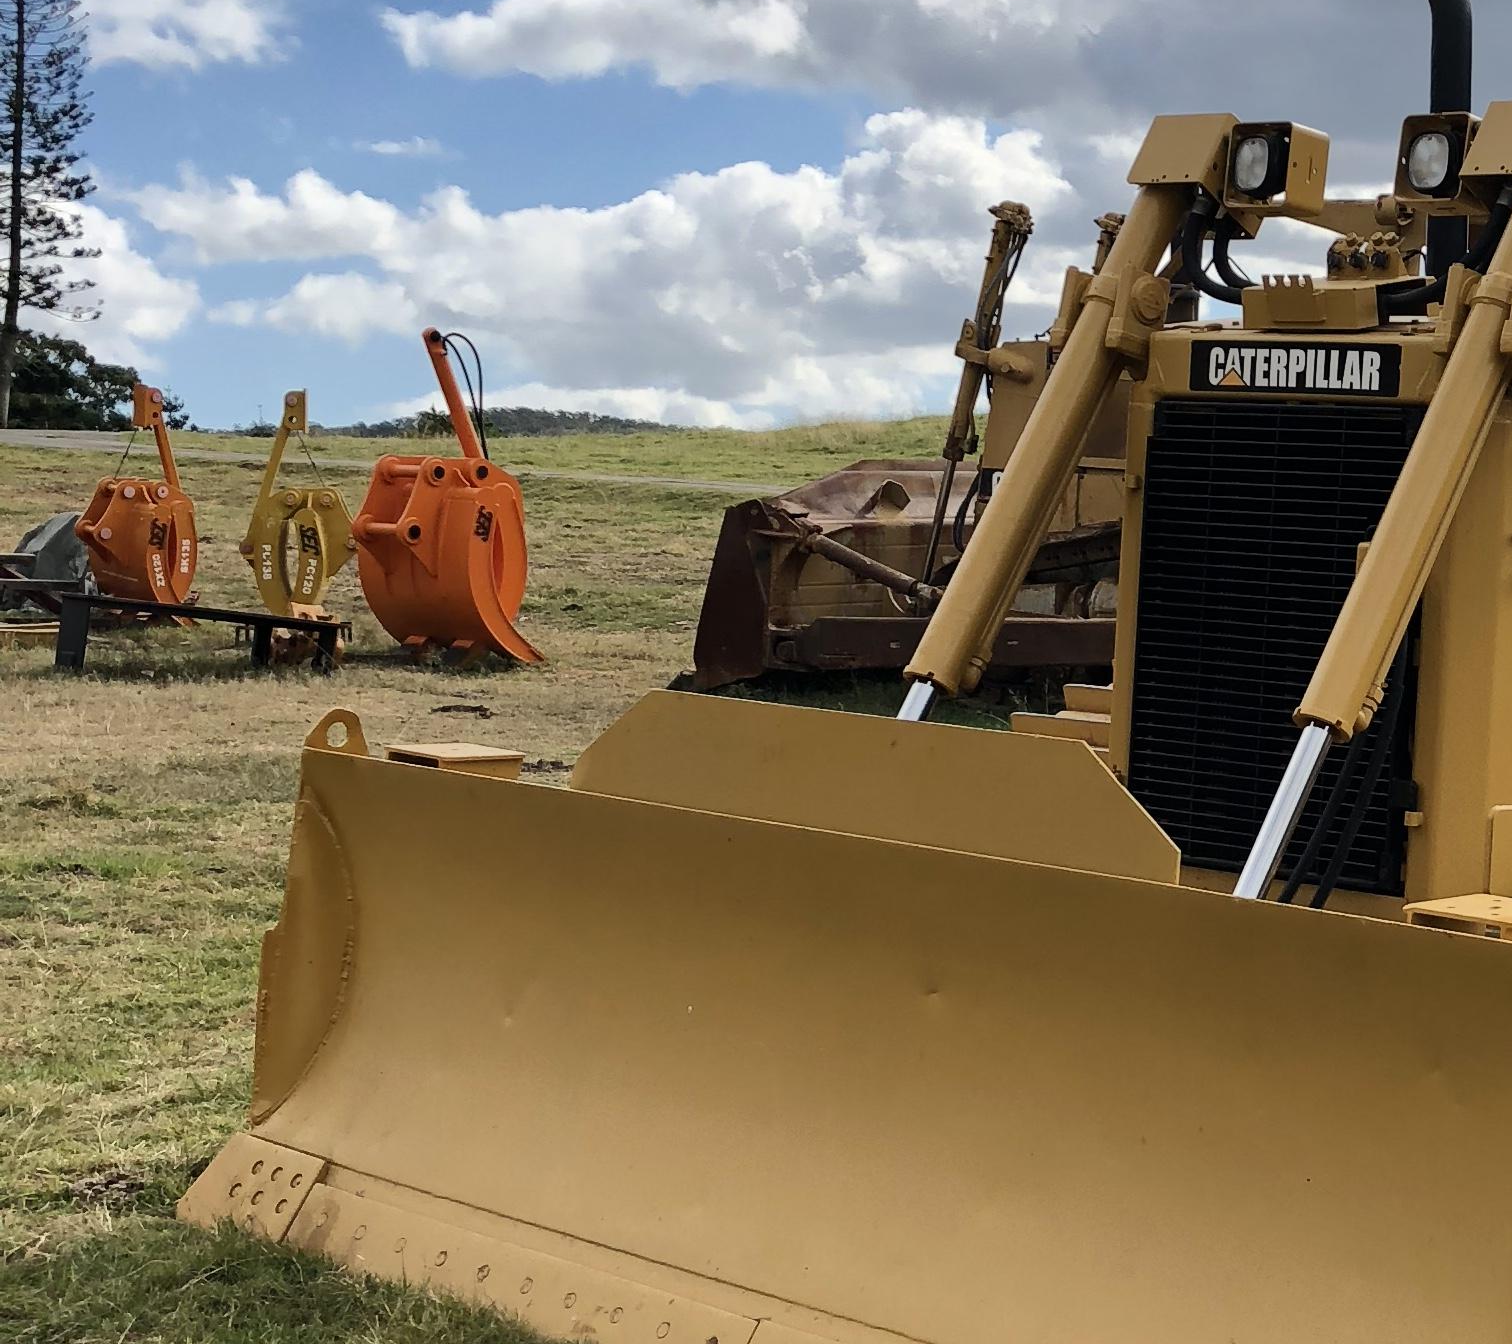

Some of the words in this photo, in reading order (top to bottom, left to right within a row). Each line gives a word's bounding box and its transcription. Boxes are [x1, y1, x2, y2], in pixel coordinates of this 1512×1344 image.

[1208, 346, 1381, 391] CATERPILLAR
[299, 524, 320, 556] SEC
[302, 558, 318, 595] PC120
